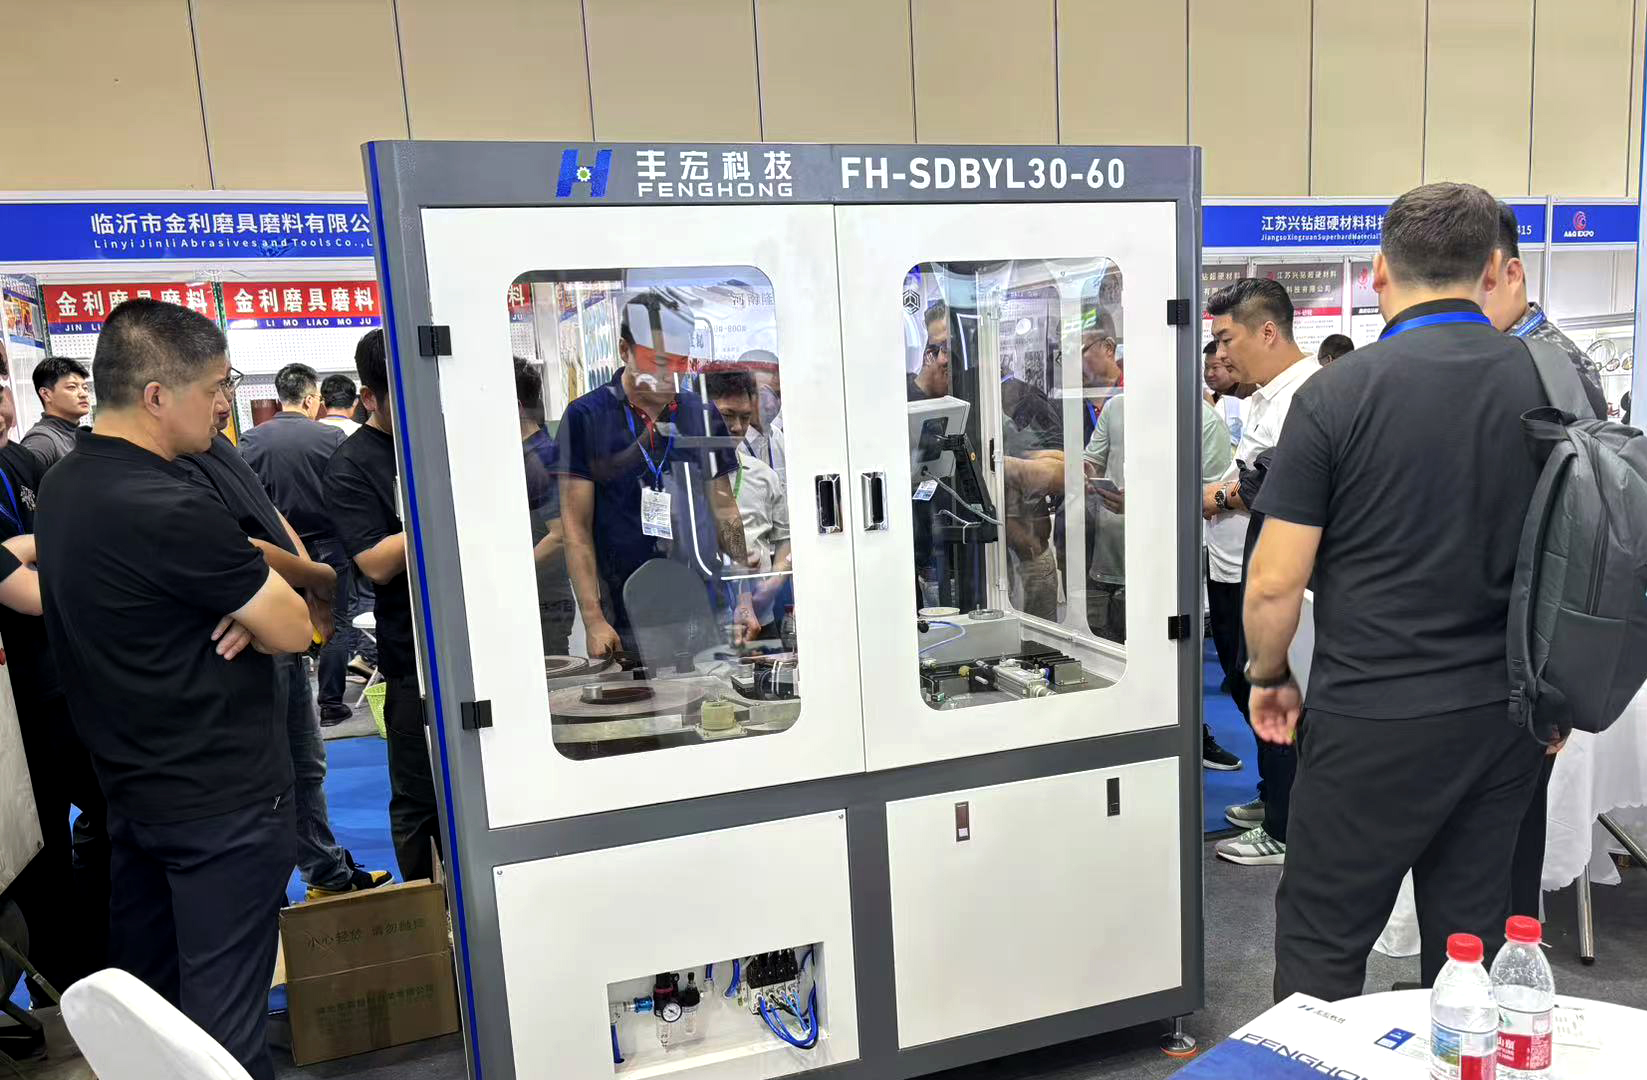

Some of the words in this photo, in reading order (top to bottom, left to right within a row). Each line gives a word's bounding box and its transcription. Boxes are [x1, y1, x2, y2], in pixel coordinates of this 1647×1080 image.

[636, 150, 792, 181] 丰宏科技
[840, 156, 1125, 190] FH-SDBYL30-60
[638, 182, 793, 198] FENGHONG
[90, 213, 371, 235] 临沂市金利磨具磨料有限公
[233, 286, 375, 314] 金利磨具磨料
[64, 324, 82, 332] JIN
[265, 319, 276, 327] LI
[283, 319, 299, 327] MO
[306, 318, 330, 327] LIAO
[337, 318, 352, 326] MO
[359, 317, 372, 325] JU
[1239, 1032, 1369, 1080] FENGHO
